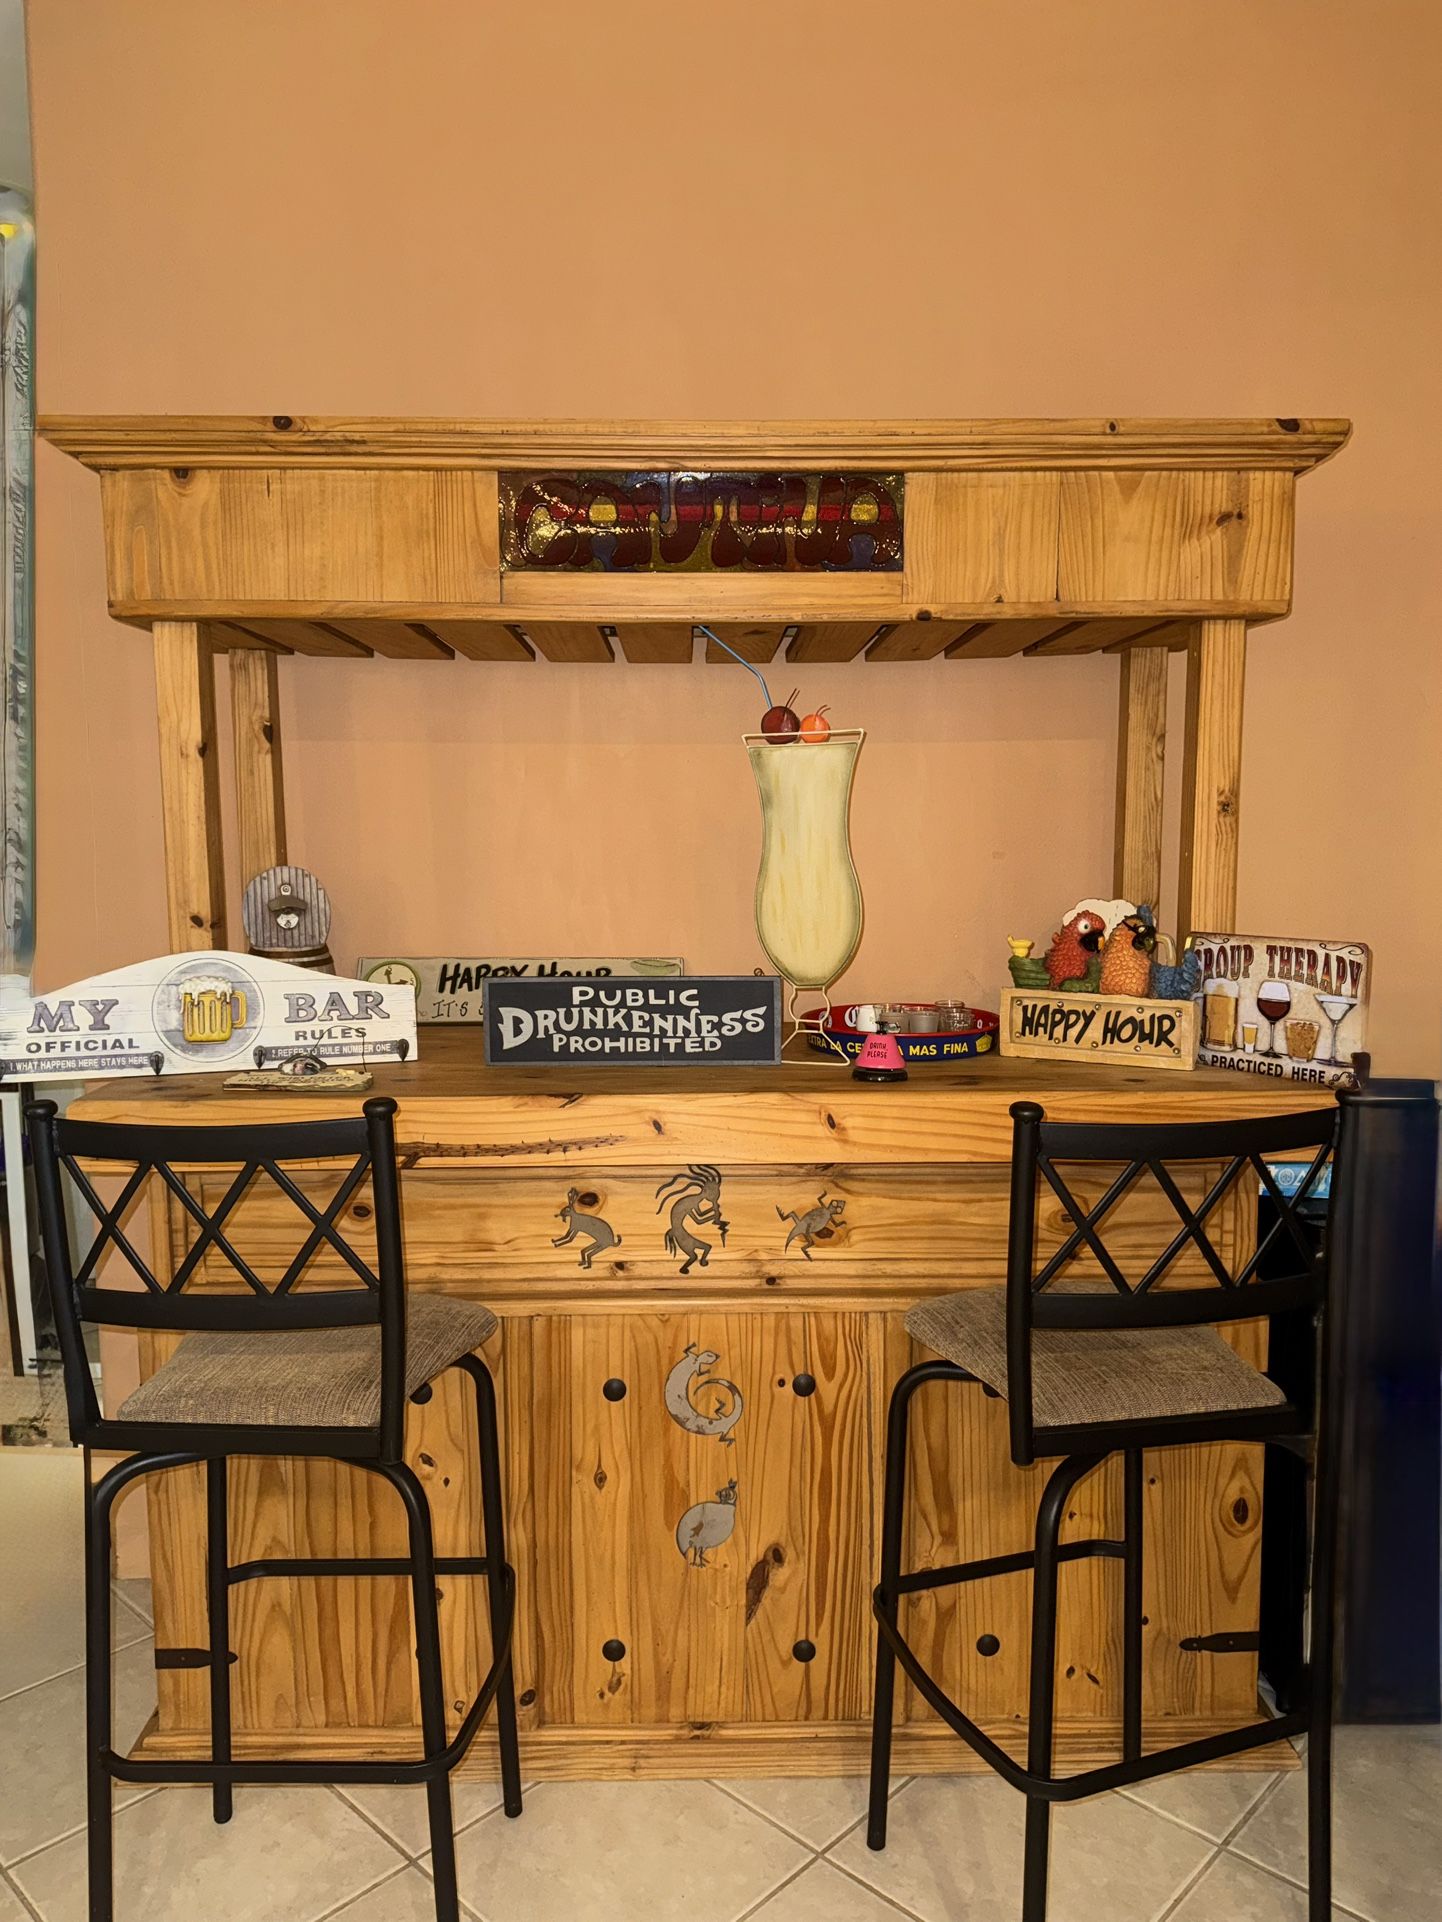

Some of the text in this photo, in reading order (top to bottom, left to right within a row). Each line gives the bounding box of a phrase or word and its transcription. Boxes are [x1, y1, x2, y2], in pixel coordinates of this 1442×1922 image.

[1266, 944, 1364, 998] THERAPY
[571, 985, 700, 1007] PUBLIC
[26, 990, 391, 1034] MY BAR
[432, 999, 469, 1019] IT'S
[498, 1005, 768, 1051] DRUNKENNESS
[1021, 1003, 1177, 1049] HAPPY HOUR
[26, 1026, 368, 1054] OFFICIAL RULES
[320, 1046, 340, 1055] RULE
[342, 1044, 374, 1055] NUMBER
[376, 1043, 391, 1052] ONE
[552, 1035, 723, 1053] PROHIBITED
[908, 1045, 938, 1056] MAS
[943, 1042, 968, 1055] FINA
[40, 1059, 76, 1070] HAPPENS
[78, 1058, 99, 1068] HERE
[101, 1057, 126, 1066] STAYS
[128, 1056, 149, 1065] HERE
[867, 1051, 888, 1059] PLEASE
[1211, 1054, 1326, 1085] PRACTICED HERE
